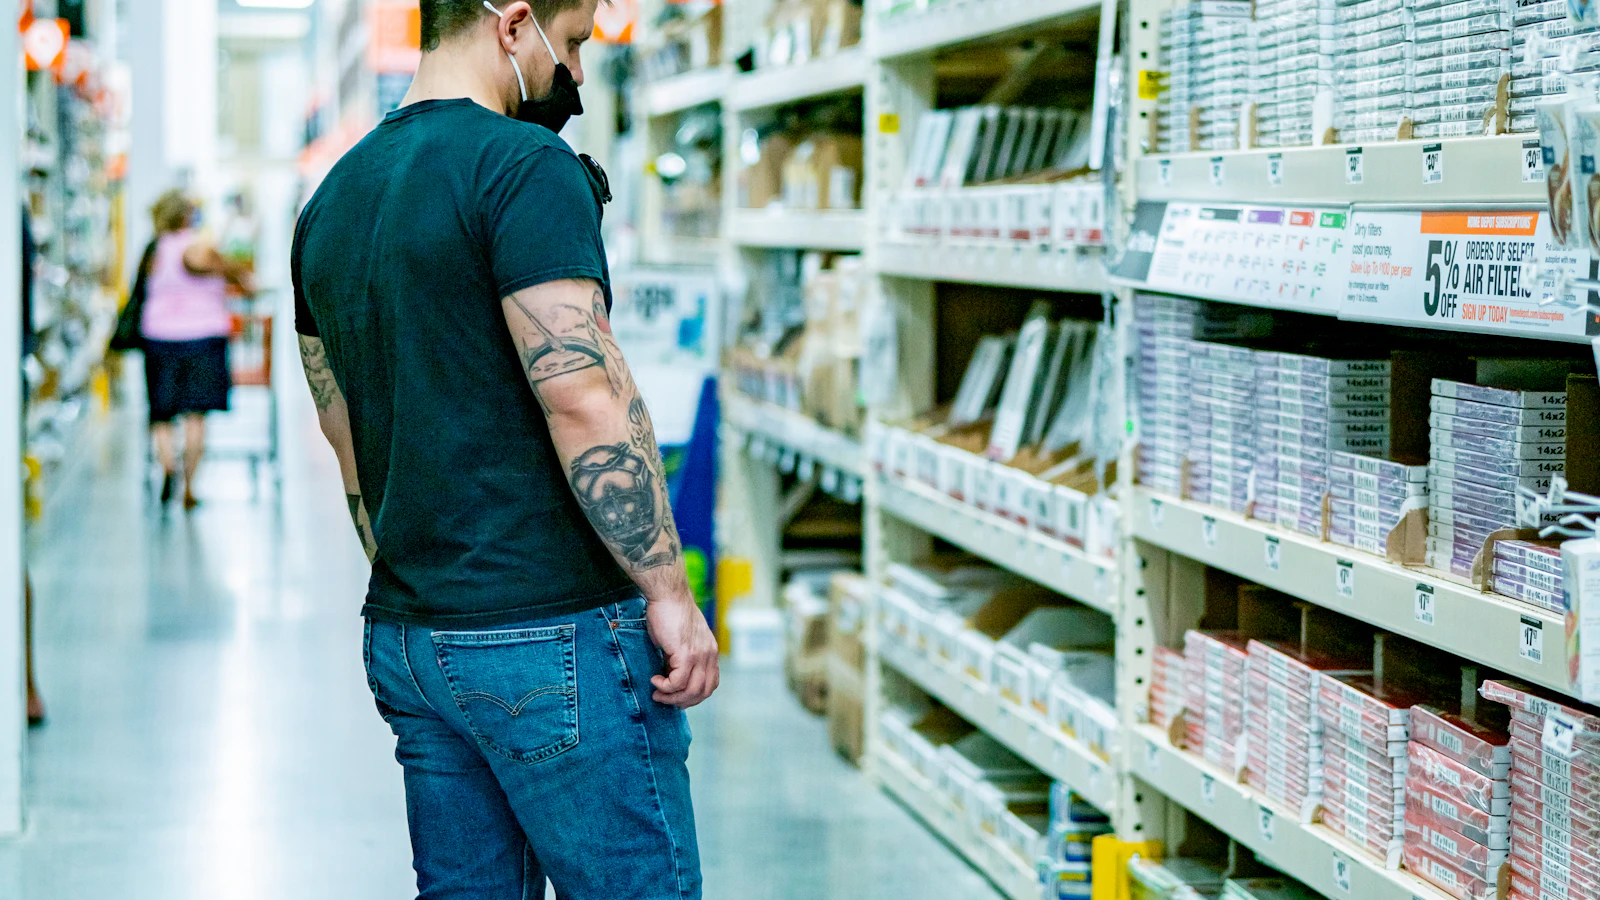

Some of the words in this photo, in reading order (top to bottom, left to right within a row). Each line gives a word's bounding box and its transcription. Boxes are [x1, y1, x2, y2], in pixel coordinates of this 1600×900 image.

[1481, 216, 1495, 228] DEPOT
[1354, 223, 1366, 238] Dirty
[1368, 223, 1382, 236] filters
[1352, 243, 1363, 255] cost
[1364, 246, 1373, 257] you
[1374, 245, 1392, 258] money.
[1466, 241, 1494, 261] ORDERS
[1496, 242, 1506, 261] OF
[1350, 260, 1362, 273] Save
[1363, 261, 1371, 276] Up
[1372, 261, 1378, 274] To
[1391, 265, 1400, 279] per
[1400, 266, 1412, 279] year
[1463, 264, 1484, 294] AIR
[1440, 293, 1457, 318] OFF
[1461, 303, 1476, 321] SIGN
[1478, 305, 1486, 321] UP
[1488, 306, 1508, 323] TODAY
[1539, 412, 1566, 420] 14x2
[1538, 429, 1566, 438] 14x2
[1537, 446, 1566, 455] 14x2
[1529, 698, 1535, 712] 14
[1540, 702, 1548, 716] 25
